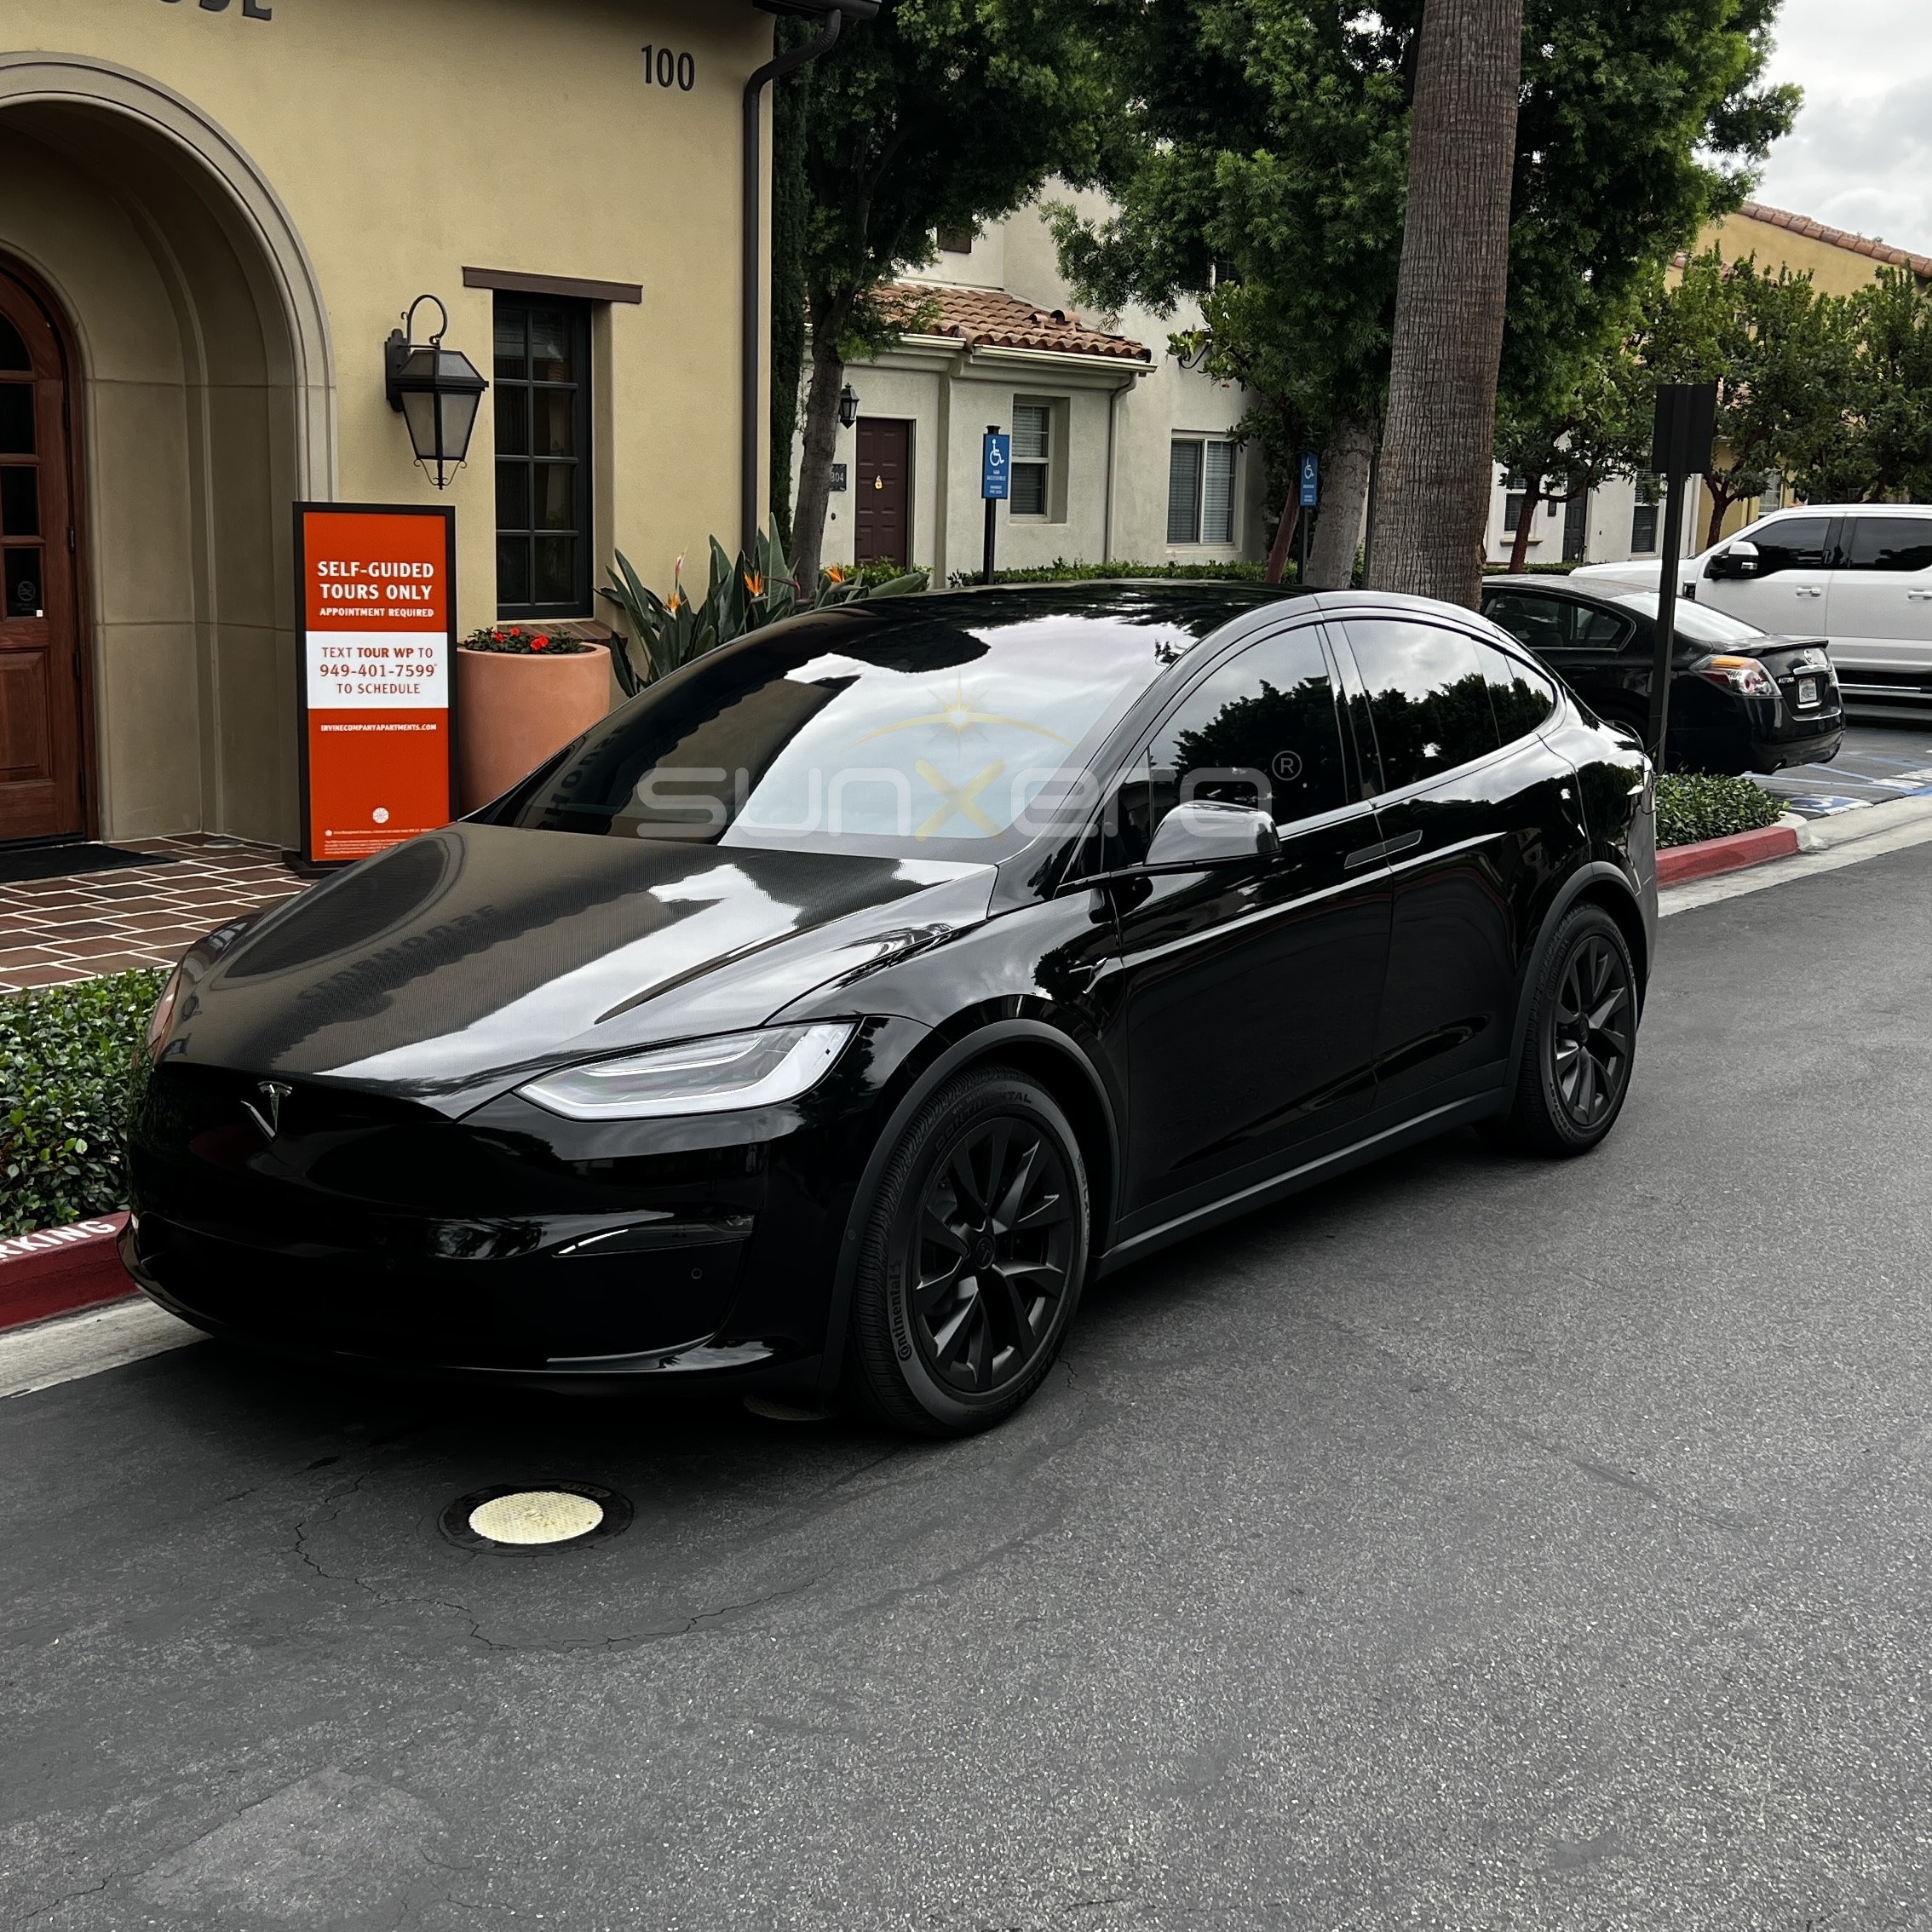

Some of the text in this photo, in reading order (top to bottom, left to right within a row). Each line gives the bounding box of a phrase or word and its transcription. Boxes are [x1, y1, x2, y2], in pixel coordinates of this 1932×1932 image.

[641, 44, 695, 91] 100
[317, 561, 434, 578] SELF-GUIDED
[319, 584, 433, 601] TOURS ONLY
[319, 607, 434, 618] APPOINTMENT REQUIRED
[322, 647, 434, 658] TEXT TOUR WP TO
[336, 683, 421, 694] TO SCHEDULE
